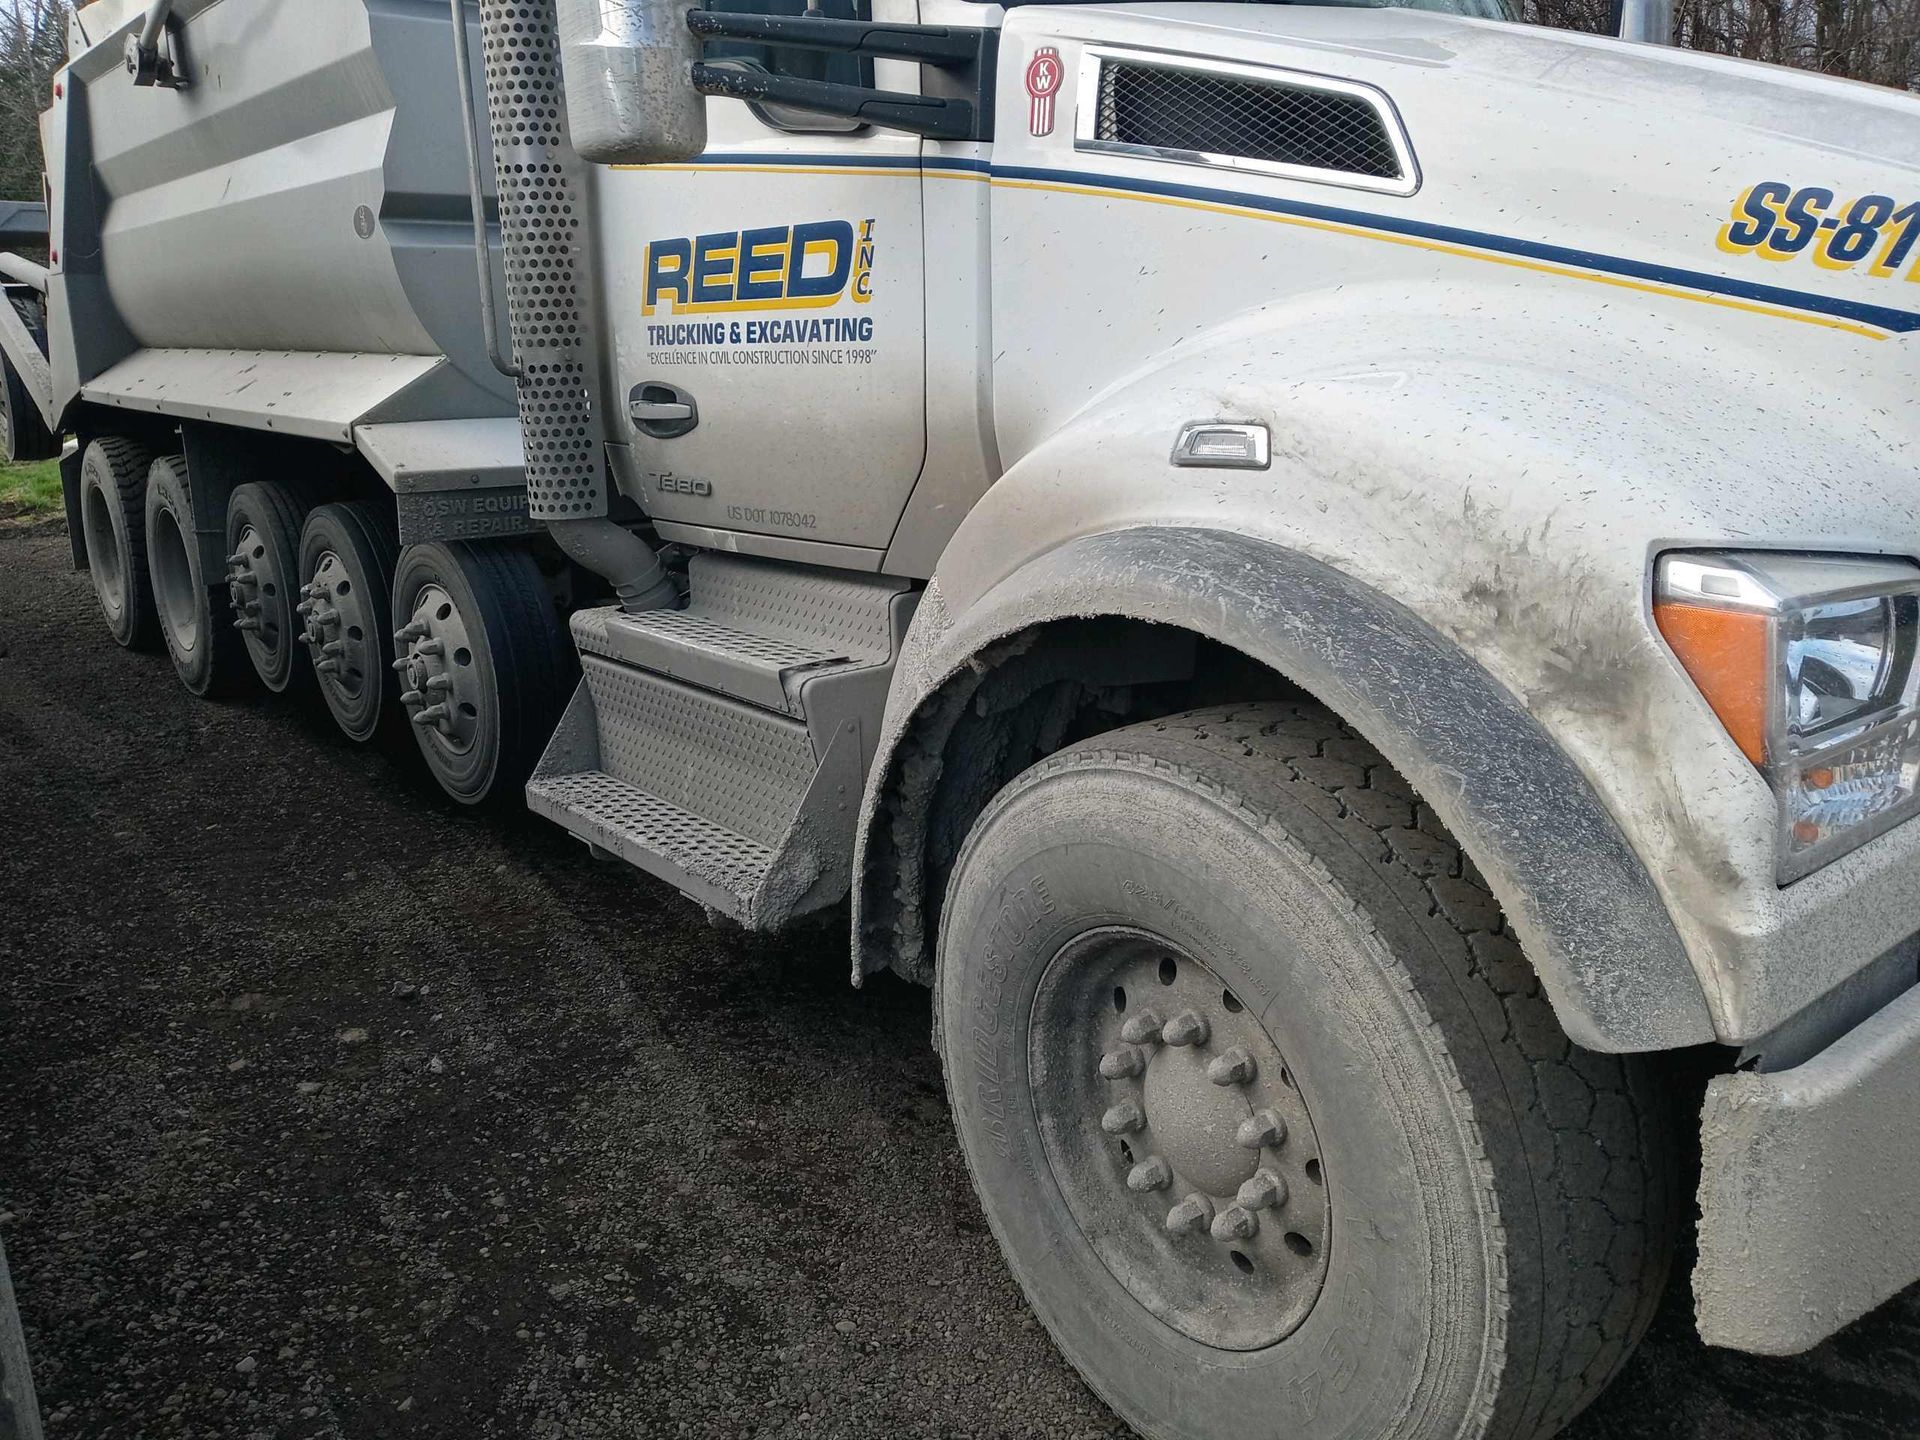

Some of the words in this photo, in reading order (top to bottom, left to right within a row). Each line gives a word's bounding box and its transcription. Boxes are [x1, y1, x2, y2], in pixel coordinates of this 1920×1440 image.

[1715, 181, 1920, 282] SS-81
[642, 219, 854, 316] REED
[647, 322, 725, 346] TRUCKING
[729, 321, 742, 344] &
[746, 316, 873, 344] EXCAVATING
[698, 351, 708, 365] IN
[709, 351, 731, 365] CIVIL
[732, 350, 810, 365] CONSTRUCTION
[812, 350, 843, 364] SINCE
[727, 505, 742, 521] US
[743, 506, 766, 523] DOT
[769, 507, 817, 529] 1078042
